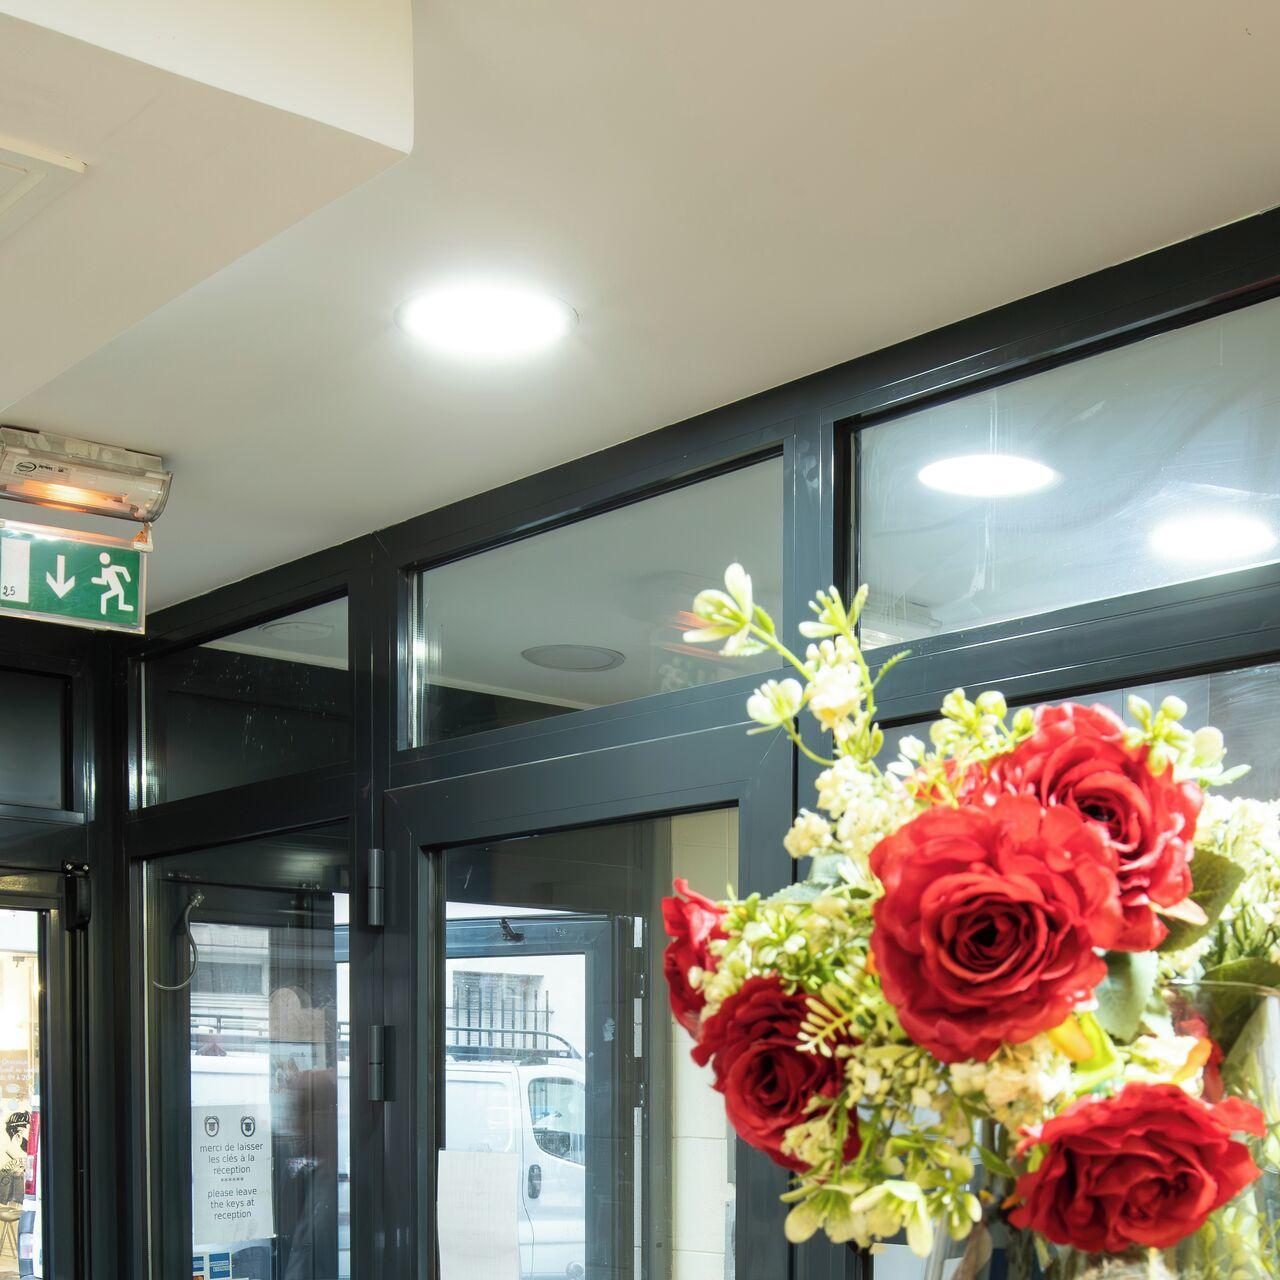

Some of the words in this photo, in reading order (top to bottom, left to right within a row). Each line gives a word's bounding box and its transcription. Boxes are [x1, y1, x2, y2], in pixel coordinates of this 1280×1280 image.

[200, 1144, 223, 1153] merci
[225, 1143, 235, 1151] de
[237, 1142, 263, 1151] laisser
[208, 1155, 219, 1164] les
[222, 1154, 238, 1163] clés
[240, 1153, 246, 1162] à
[248, 1153, 255, 1162] la
[207, 1187, 234, 1199] please
[236, 1187, 257, 1195] leave
[210, 1201, 224, 1209] the
[226, 1200, 244, 1210] keys
[246, 1199, 254, 1207] at
[214, 1209, 252, 1220] reception
